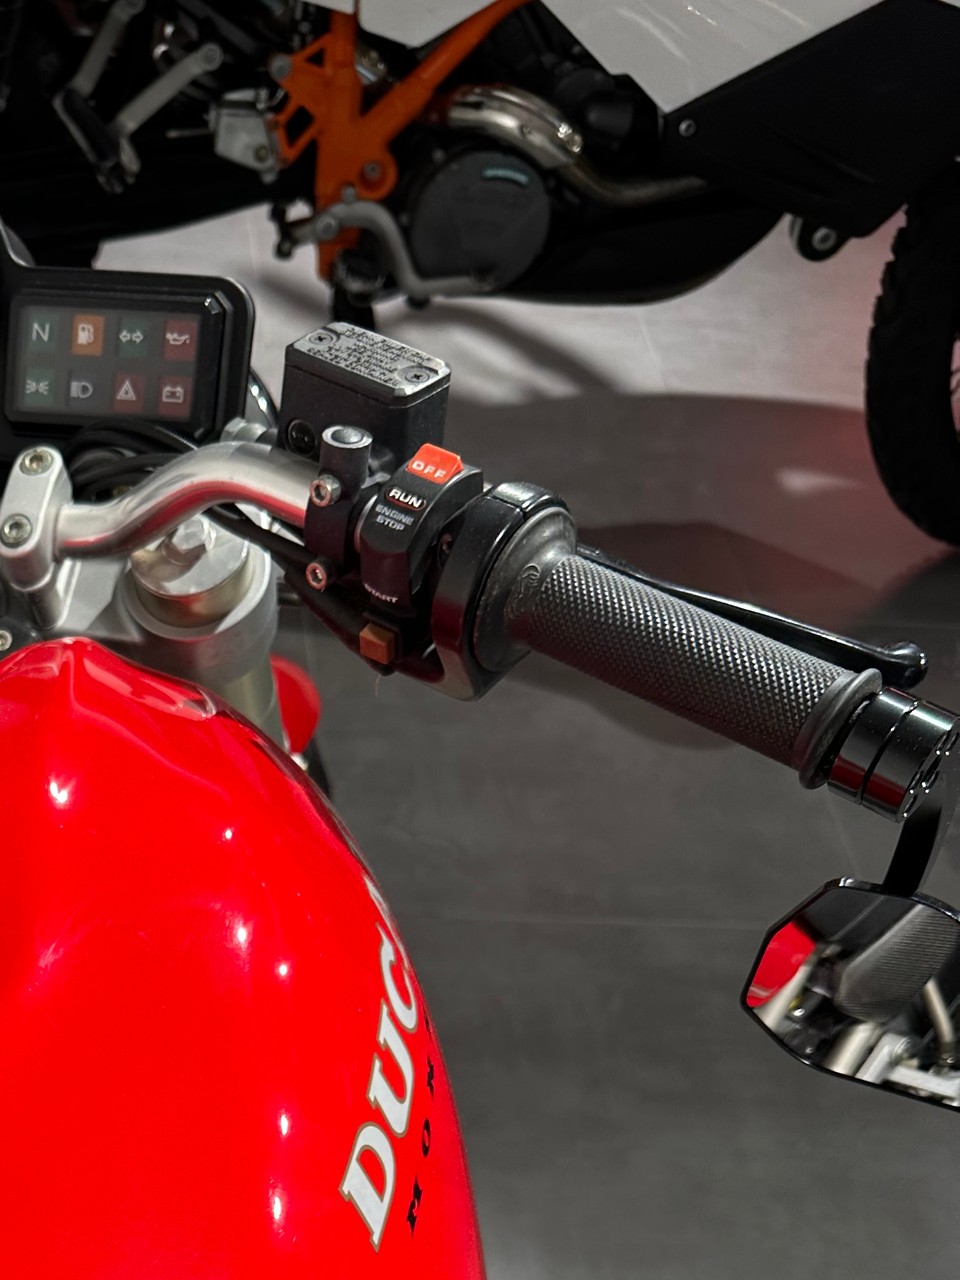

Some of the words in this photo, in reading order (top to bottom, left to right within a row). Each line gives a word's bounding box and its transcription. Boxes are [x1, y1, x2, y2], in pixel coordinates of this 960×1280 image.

[32, 323, 50, 342] N
[412, 460, 446, 479] OFF
[389, 488, 422, 508] RUN
[375, 504, 414, 526] ENGINE
[376, 515, 405, 531] STOP
[364, 583, 398, 603] START
